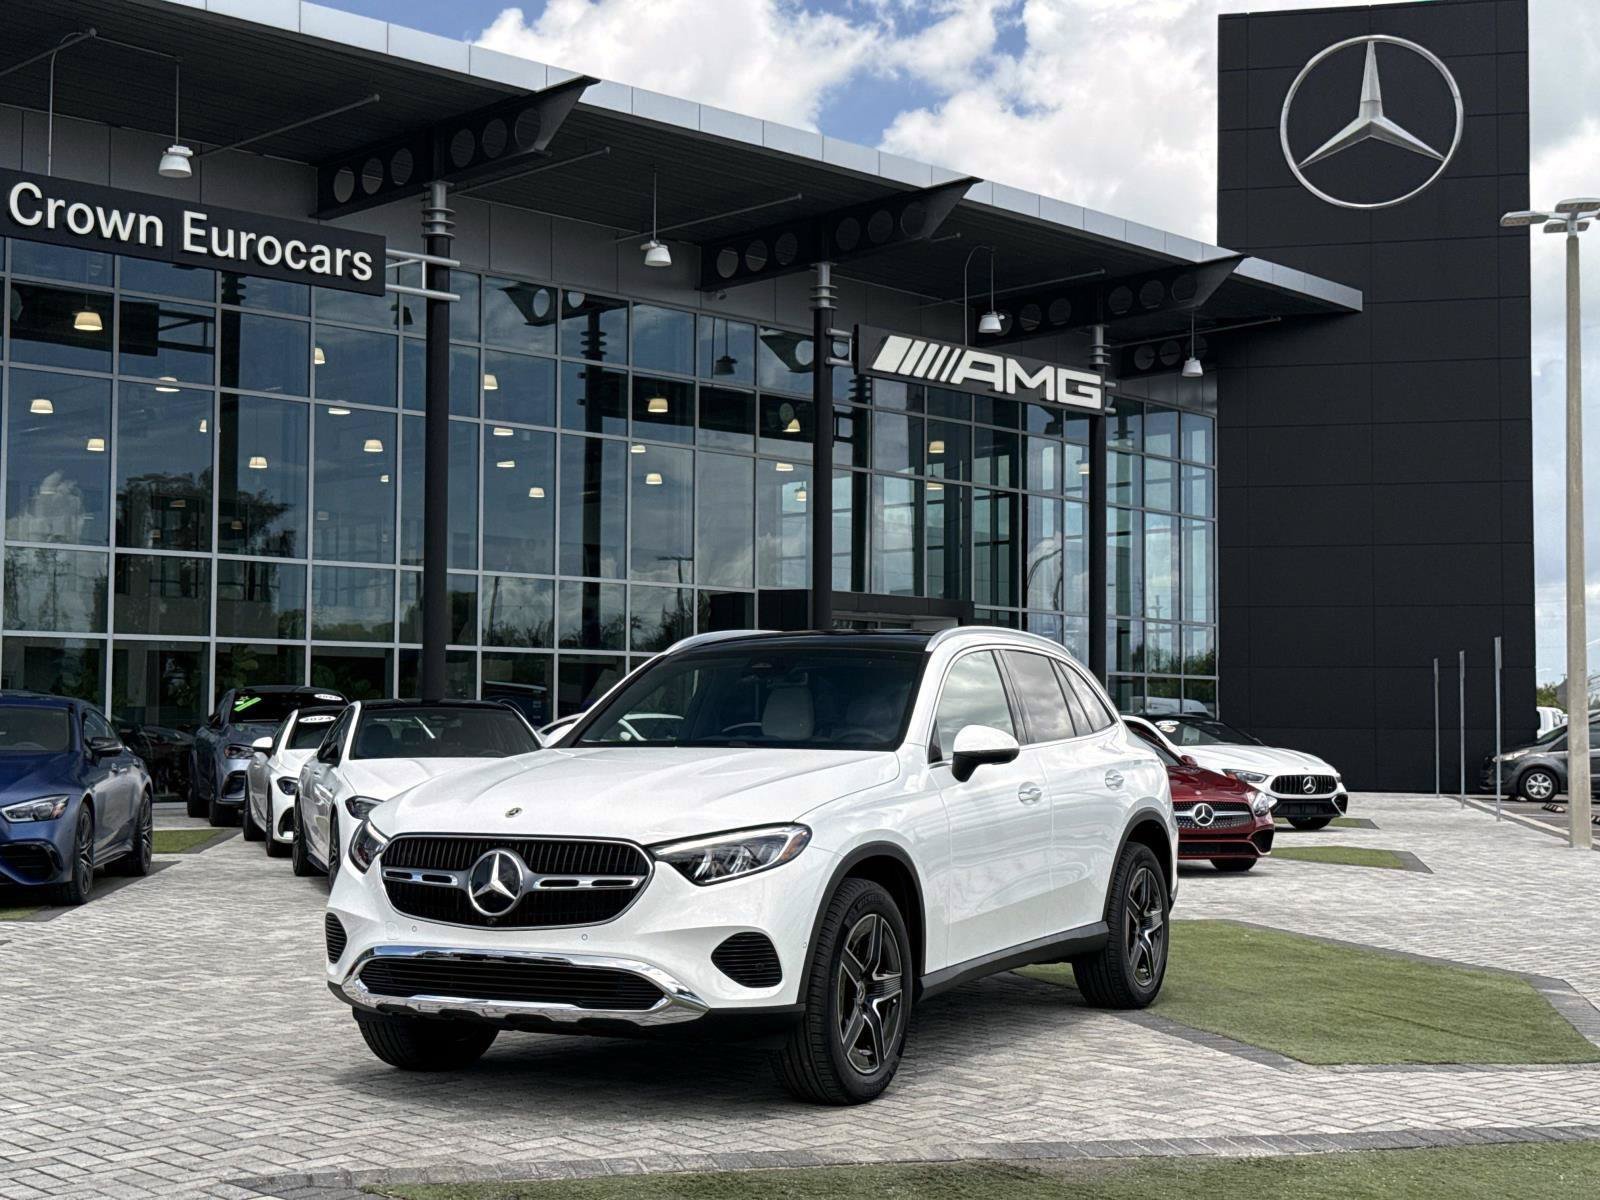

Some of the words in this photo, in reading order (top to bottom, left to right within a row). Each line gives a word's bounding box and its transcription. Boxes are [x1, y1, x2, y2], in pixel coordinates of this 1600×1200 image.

[9, 181, 164, 247] Crown
[183, 210, 373, 281] Eurocars
[950, 349, 1102, 409] AMG
